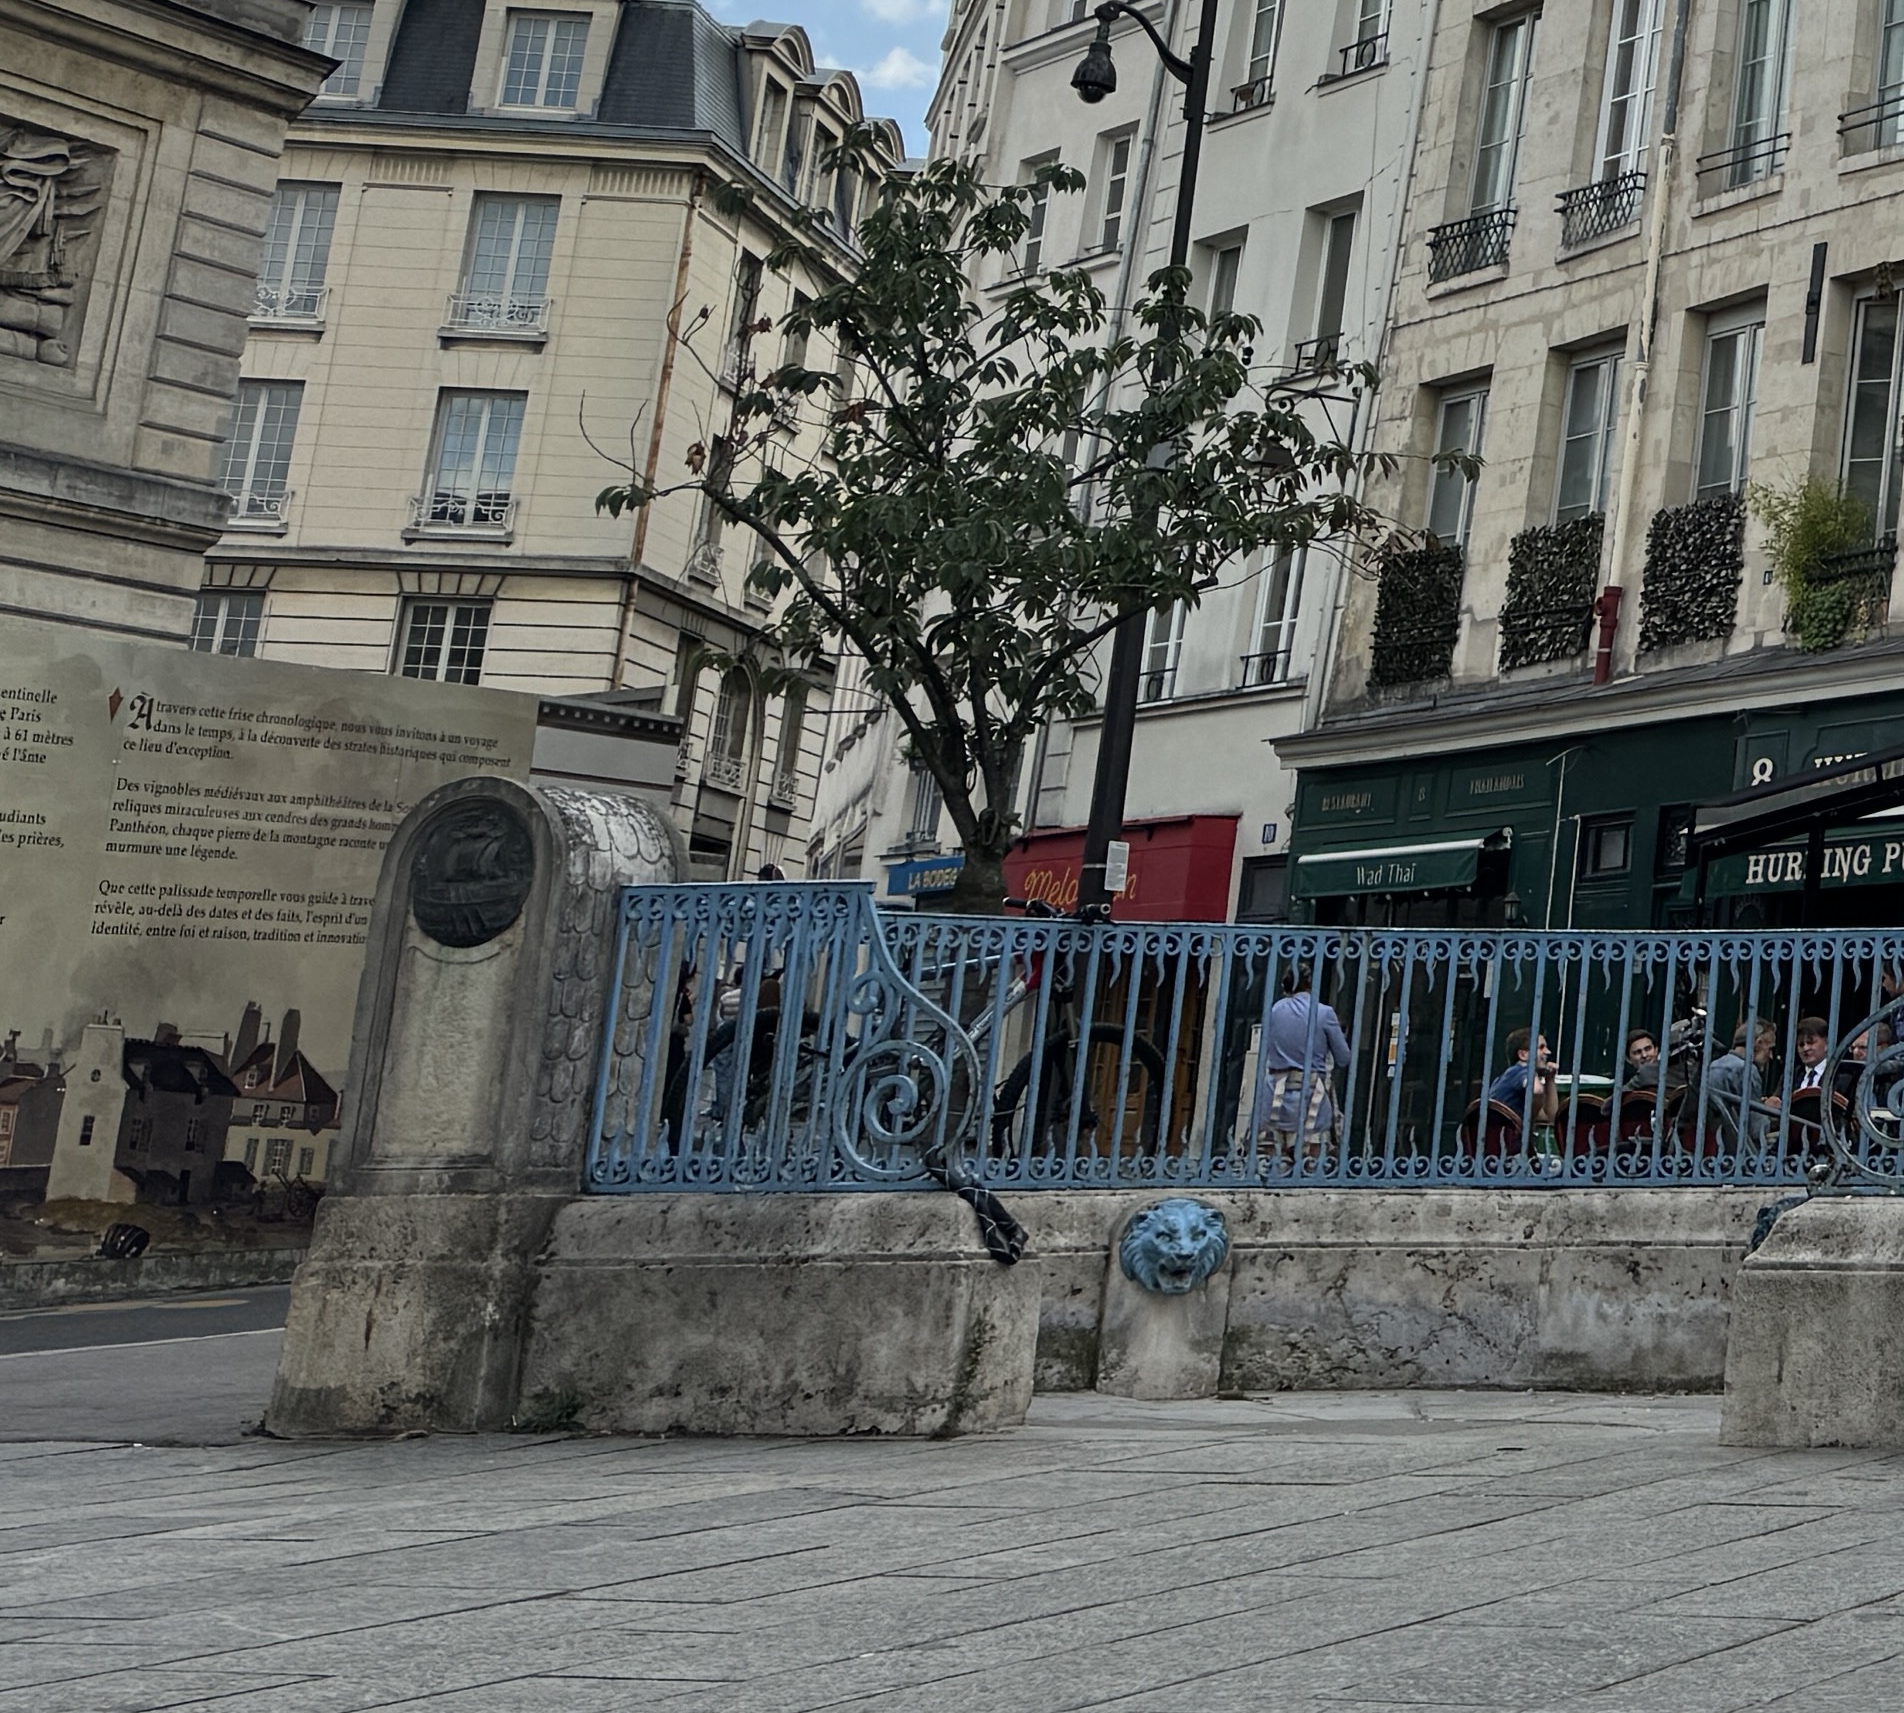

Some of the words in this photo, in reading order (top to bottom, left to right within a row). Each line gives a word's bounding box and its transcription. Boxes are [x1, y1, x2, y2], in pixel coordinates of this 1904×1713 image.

[0, 687, 58, 704] entinelle
[10, 706, 42, 723] Paris
[156, 701, 197, 716] travers
[198, 705, 226, 719] cette
[227, 707, 255, 724] frise
[255, 710, 338, 731] chronologique,
[341, 719, 367, 733] nous
[369, 724, 394, 737] vous
[395, 725, 438, 743] invitons
[439, 731, 446, 743] à
[448, 733, 461, 745] un
[464, 737, 498, 751] voyage
[15, 728, 28, 742] 61
[32, 730, 74, 746] mètres
[123, 740, 137, 751] ce
[139, 738, 162, 753] lieu
[165, 741, 234, 761] d'exception.
[153, 719, 181, 735] dans
[185, 723, 196, 736] le
[198, 726, 236, 743] temps,
[238, 727, 245, 741] à
[248, 729, 258, 742] la
[260, 730, 320, 749] découverte
[323, 735, 342, 751] des
[344, 739, 378, 754] strates
[379, 741, 438, 762] historiques
[439, 750, 456, 764] qui
[459, 753, 511, 768] composent
[116, 777, 139, 792] Des
[144, 780, 201, 798] vignobles
[203, 785, 264, 803] médiévaux
[267, 794, 287, 804] aux
[290, 794, 366, 811] amphithéâtres
[369, 798, 381, 812] de
[384, 799, 393, 813] la
[112, 799, 162, 817] reliques
[164, 802, 240, 820] miraculeuses
[242, 811, 262, 822] aux
[265, 811, 307, 826] cendres
[310, 813, 328, 827] des
[331, 816, 367, 832] grands
[17, 831, 66, 848] prières,
[109, 818, 169, 836] Panthéon,
[172, 823, 214, 841] chaque
[217, 828, 250, 843] pierre
[252, 828, 267, 842] de
[269, 830, 280, 843] la
[282, 833, 337, 850] montagne
[339, 835, 378, 849] raconte
[105, 841, 162, 855] murmure
[165, 845, 188, 857] une
[190, 844, 238, 861] légende.
[1745, 844, 1873, 884] HURING
[922, 866, 960, 889] BODEG
[99, 879, 126, 895] Que
[128, 883, 156, 896] cette
[158, 883, 214, 900] palissade
[216, 887, 277, 904] temporelle
[279, 893, 306, 903] vous
[308, 891, 339, 907] guide
[340, 892, 348, 905] à
[94, 899, 135, 916] révèle,
[138, 903, 183, 917] au-delà
[186, 905, 206, 919] des
[208, 906, 238, 920] dates
[241, 909, 252, 920] et
[254, 908, 274, 922] des
[276, 909, 303, 925] faits,
[305, 910, 343, 927] l'esprit
[145, 924, 177, 938] entre
[179, 923, 196, 939] foi
[198, 927, 210, 939] et
[212, 928, 250, 942] raison,
[252, 928, 301, 943] tradition
[303, 932, 315, 944] et
